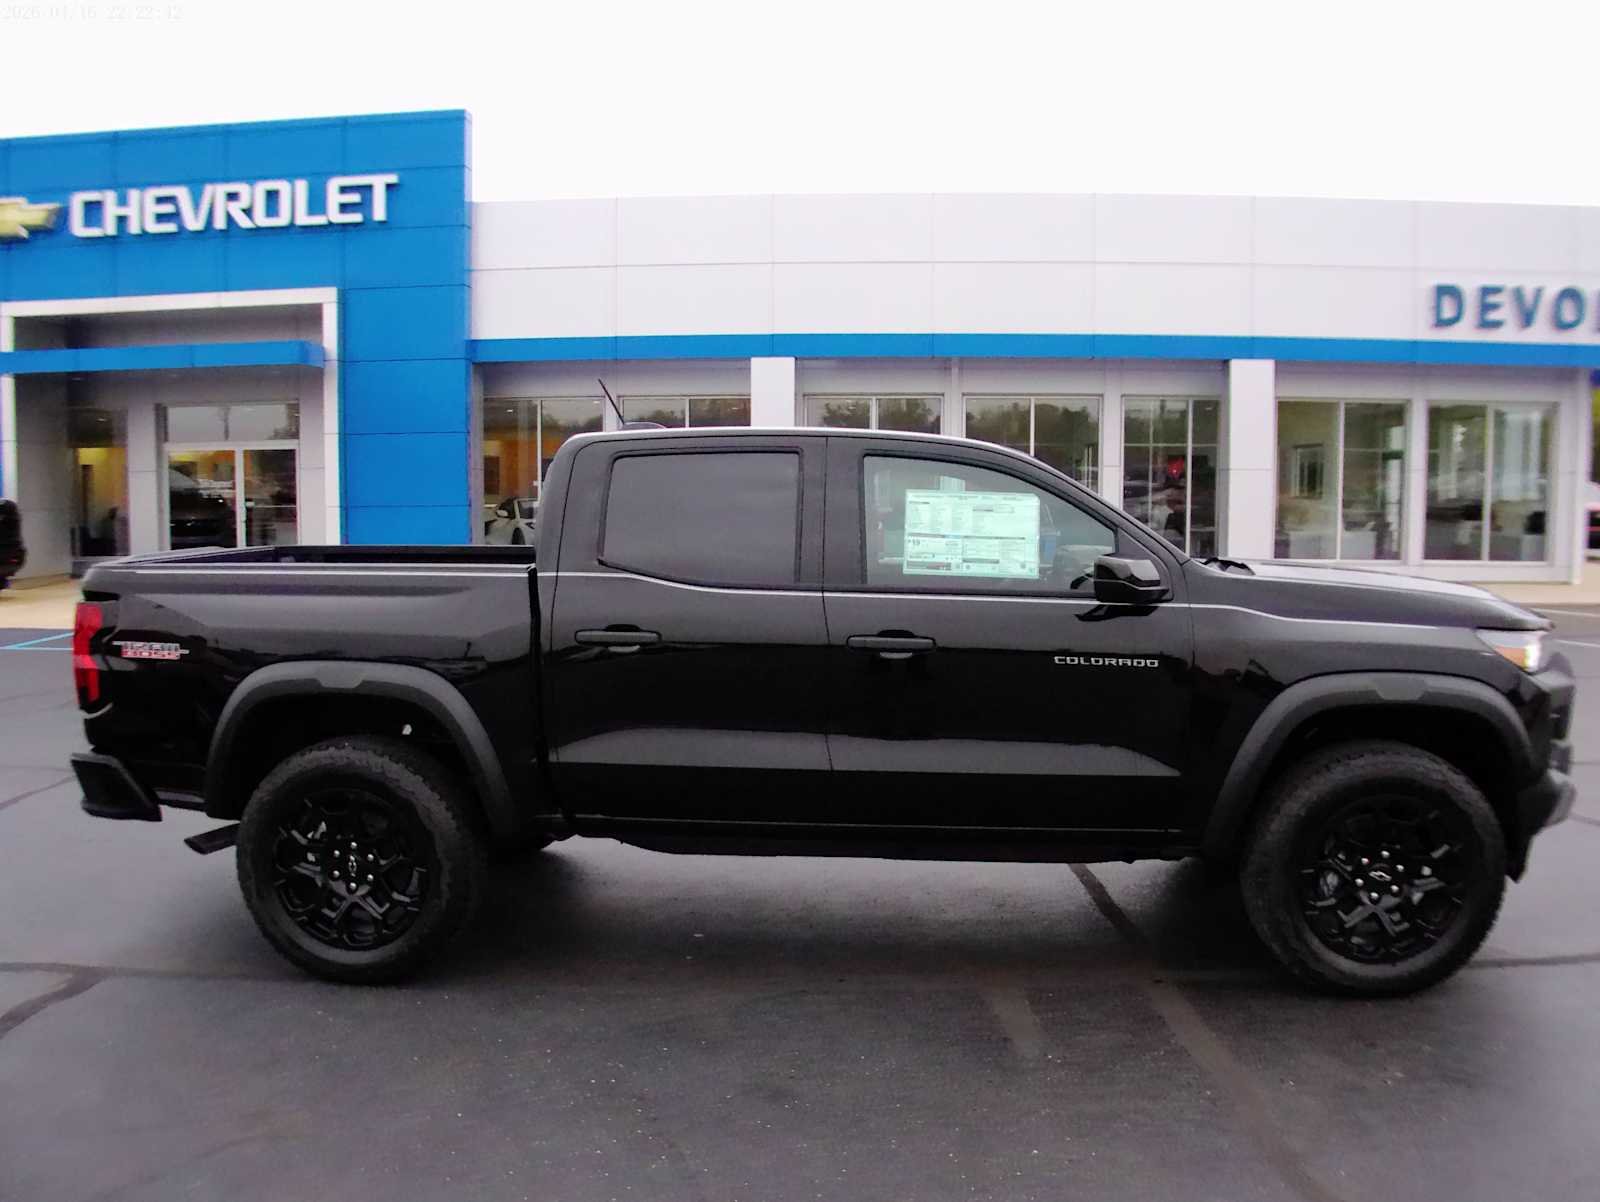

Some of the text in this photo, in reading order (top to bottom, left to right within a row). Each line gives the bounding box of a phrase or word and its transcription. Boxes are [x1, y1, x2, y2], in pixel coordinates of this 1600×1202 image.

[70, 173, 399, 238] CHEVROLET
[1431, 284, 1600, 332] DEVO
[1054, 656, 1159, 668] COLORADO
